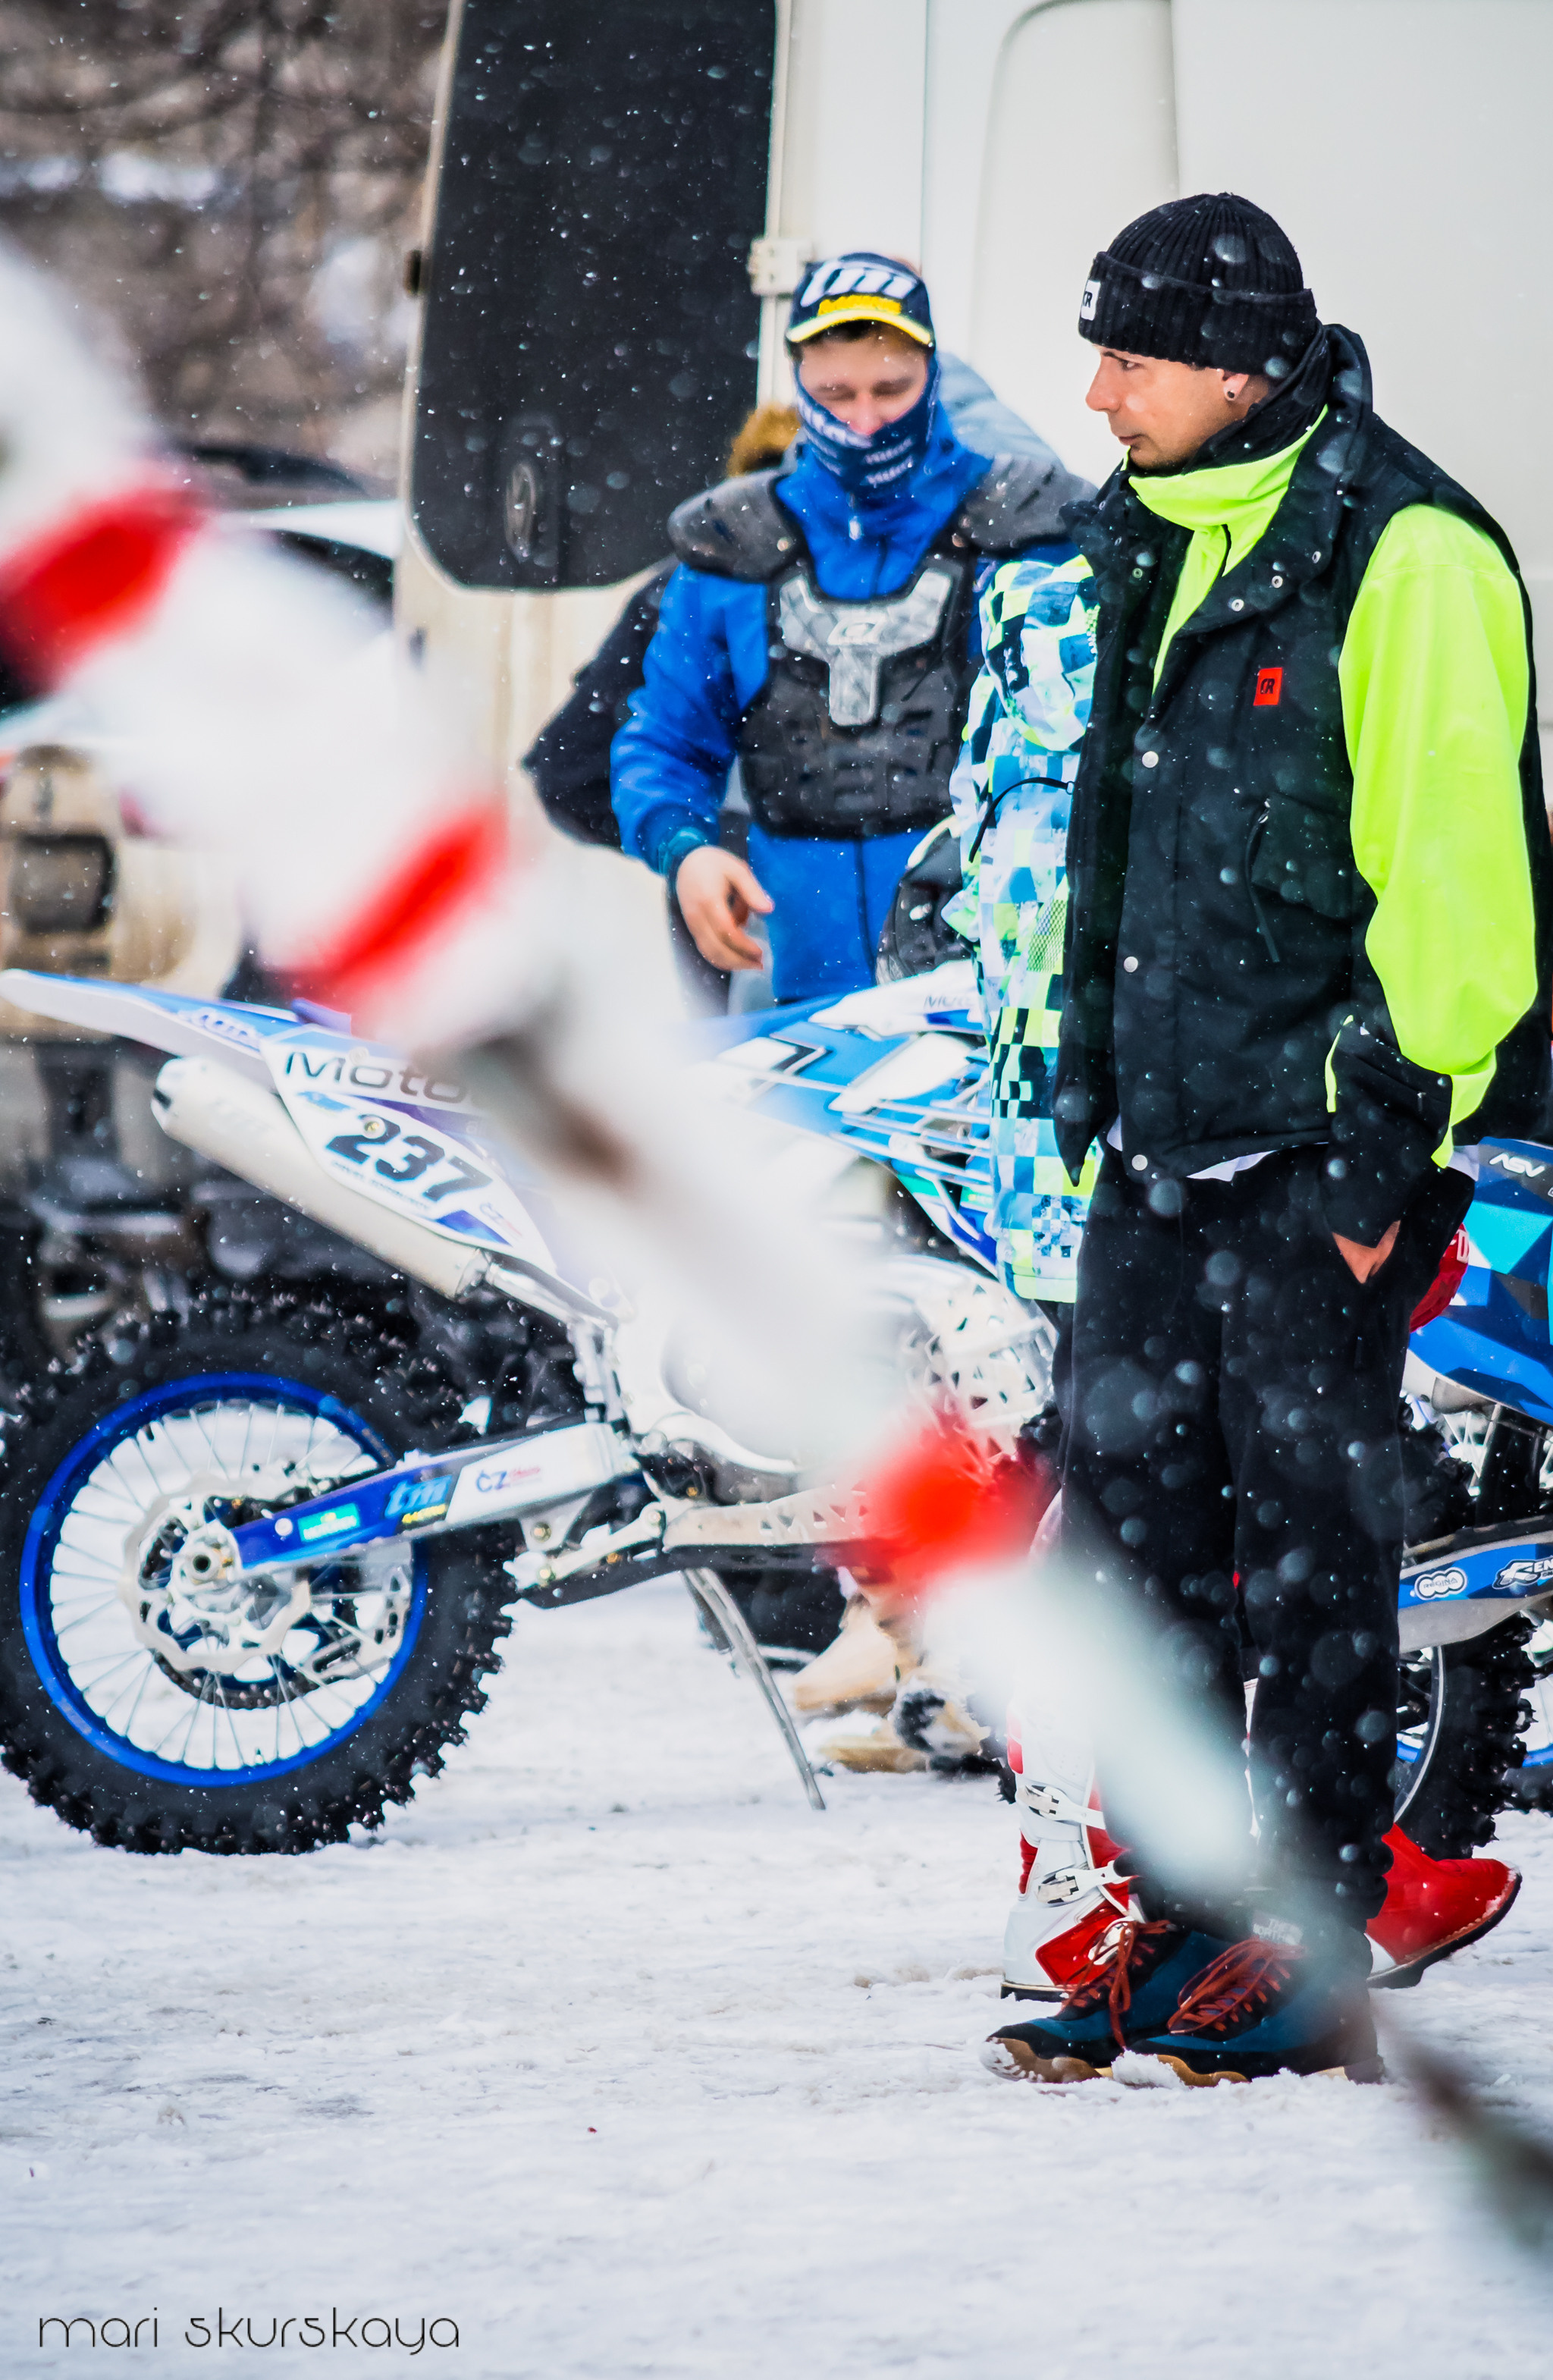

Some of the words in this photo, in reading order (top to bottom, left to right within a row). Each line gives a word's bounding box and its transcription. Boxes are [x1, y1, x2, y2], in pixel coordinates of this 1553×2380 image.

[326, 1113, 493, 1203] 237
[1489, 1153, 1545, 1178] ASV
[384, 1476, 452, 1516] tm
[1423, 1576, 1458, 1589] REGINA
